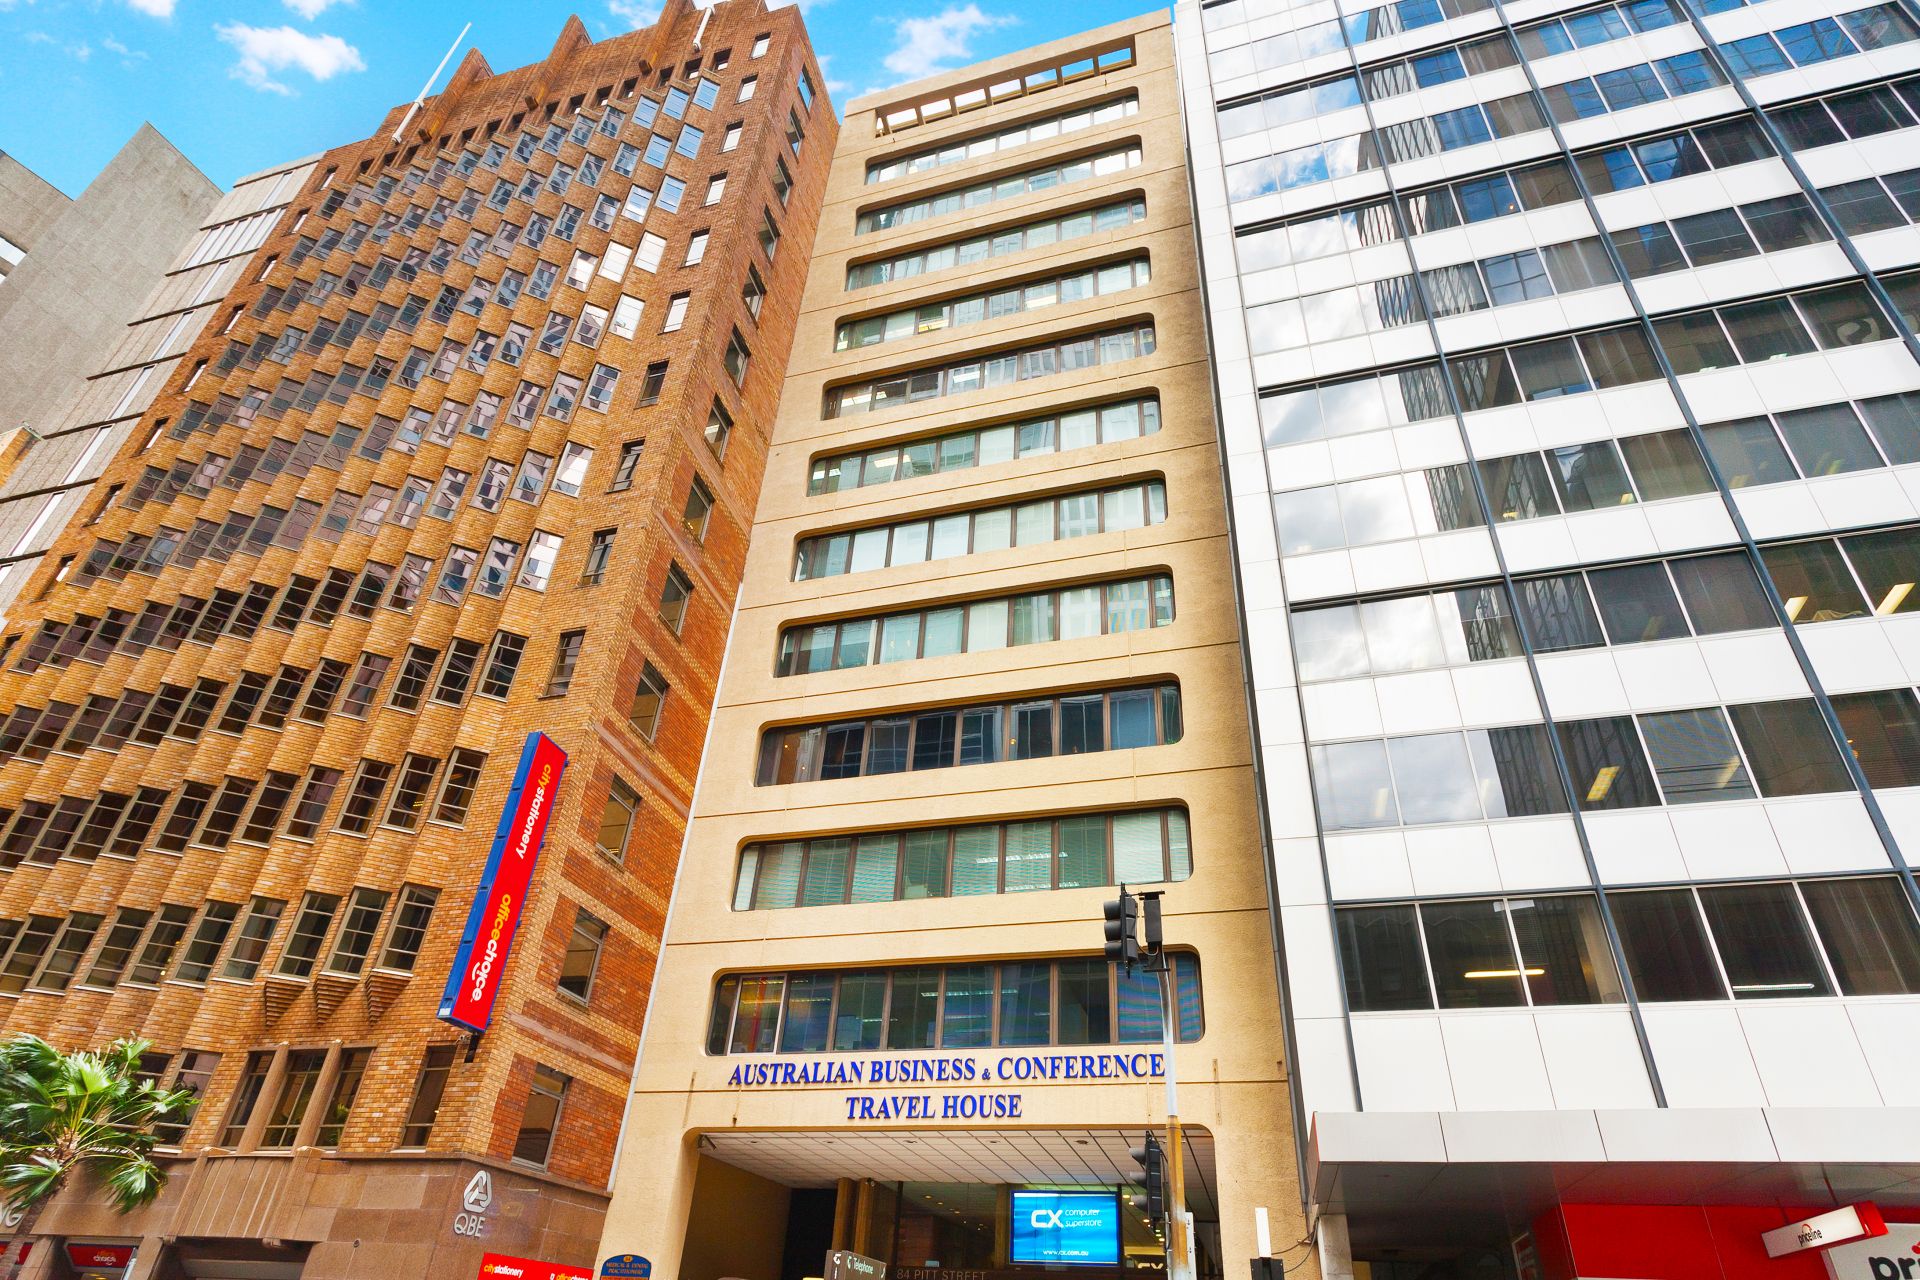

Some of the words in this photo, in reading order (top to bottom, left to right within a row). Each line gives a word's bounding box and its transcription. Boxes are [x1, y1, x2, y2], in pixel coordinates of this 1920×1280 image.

[515, 764, 551, 860] citystationery
[471, 893, 511, 1002] officechoice
[728, 1060, 865, 1086] AUSTRALIAN
[869, 1057, 976, 1083] BUSINESS
[981, 1067, 991, 1080] &
[997, 1053, 1166, 1080] CONFERENCE
[846, 1095, 936, 1120] TRAVEL
[941, 1093, 1023, 1119] HOUSE
[454, 1213, 485, 1237] QBE
[1031, 1209, 1063, 1228] CX
[1064, 1209, 1100, 1217] computer
[1065, 1219, 1103, 1227] superstore
[1798, 1228, 1823, 1247] priceline
[483, 1264, 524, 1278] citystationery
[853, 1256, 874, 1275] Telephone
[896, 1269, 910, 1280] 84
[914, 1269, 938, 1280] PITT
[942, 1270, 986, 1280] STREET
[1868, 1256, 1920, 1280] pr
